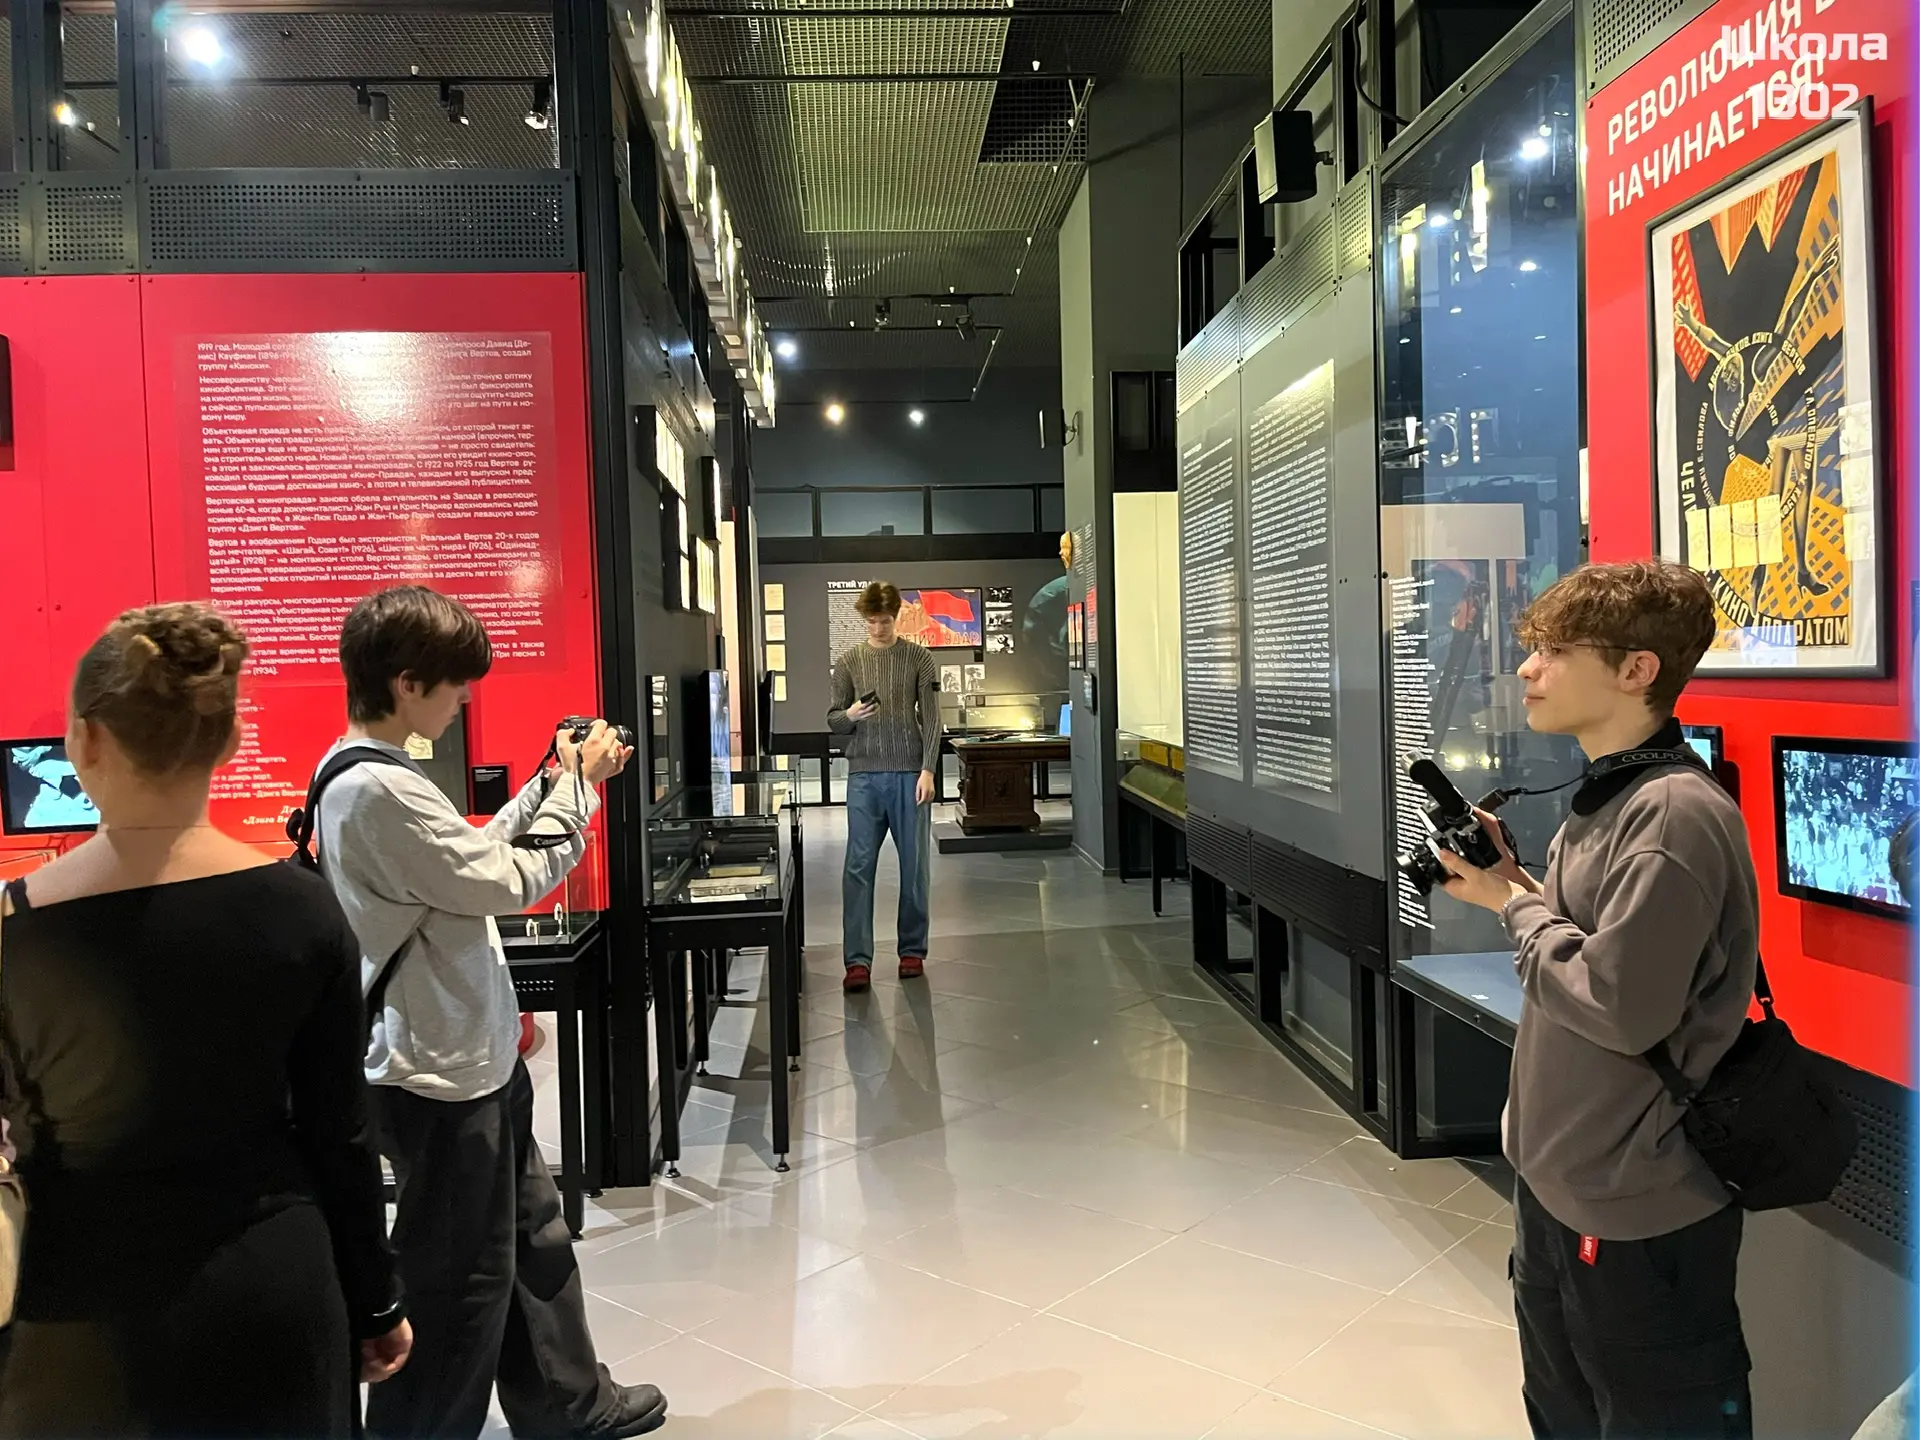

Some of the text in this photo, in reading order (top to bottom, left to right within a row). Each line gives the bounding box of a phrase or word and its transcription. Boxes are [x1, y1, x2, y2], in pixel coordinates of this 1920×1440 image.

[1608, 0, 1801, 155] РЕВОЛЮЦИЯ
[1608, 43, 1825, 216] НАЧИНАЕТСЯ!
[232, 343, 270, 351] Молодой
[486, 340, 513, 348] Давид
[218, 352, 256, 360] Кауфман
[1781, 340, 1806, 375] ВЕРТОВ
[199, 376, 270, 384] Несовершенству
[504, 373, 532, 381] оптику
[460, 382, 477, 390] был
[479, 382, 533, 390] фиксировать
[463, 424, 496, 432] которой
[225, 436, 281, 444] Объективную
[441, 433, 476, 441] камерой
[1804, 410, 1816, 470] ОПЕРАТОР
[460, 442, 488, 450] просто
[220, 455, 263, 463] строитель
[457, 451, 487, 459] увидит
[305, 463, 352, 471] вертовская
[455, 460, 473, 468] 1925
[490, 460, 519, 468] Вертов
[242, 473, 289, 481] созданием
[291, 472, 347, 480] киножурнала
[418, 470, 452, 478] каждым
[470, 469, 510, 477] выпуском
[407, 479, 470, 487] телевизионной
[205, 496, 254, 505] Вертовская
[350, 494, 380, 502] обрела
[382, 494, 438, 502] актуальность
[452, 493, 483, 501] Западе
[257, 506, 282, 514] когда
[282, 505, 352, 513] документалисты
[374, 503, 391, 512] Руш
[399, 503, 419, 511] Крис
[421, 502, 452, 511] Маркер
[453, 502, 511, 510] вдохновились
[513, 501, 538, 509] идеей
[292, 513, 331, 521] Жан-Люк
[333, 513, 357, 521] Годар
[367, 512, 409, 521] Жан-Пьер
[473, 511, 513, 519] левацкую
[207, 538, 238, 546] Вертов
[248, 537, 305, 546] воображении
[307, 536, 336, 544] Годара
[463, 533, 493, 541] Вертов
[208, 548, 226, 556] был
[366, 553, 400, 562] Вертова
[473, 552, 528, 560] хроникерами
[263, 565, 325, 574] превращались
[210, 575, 268, 584] воплощением
[290, 573, 329, 582] открытий
[337, 573, 371, 581] находок
[399, 571, 433, 580] Вертова
[444, 571, 473, 579] десять
[827, 580, 857, 589] ТРЕТИЙ
[211, 597, 341, 607] Острые многократные
[276, 606, 330, 615] убыстренная
[1712, 576, 1848, 646] КИНО АППАРАТОМ
[272, 615, 330, 624] Непрерывные
[249, 625, 319, 634] противостоянию
[279, 647, 315, 655] времена
[259, 657, 317, 665] знаменитыми
[1621, 752, 1685, 762] COOLPIX
